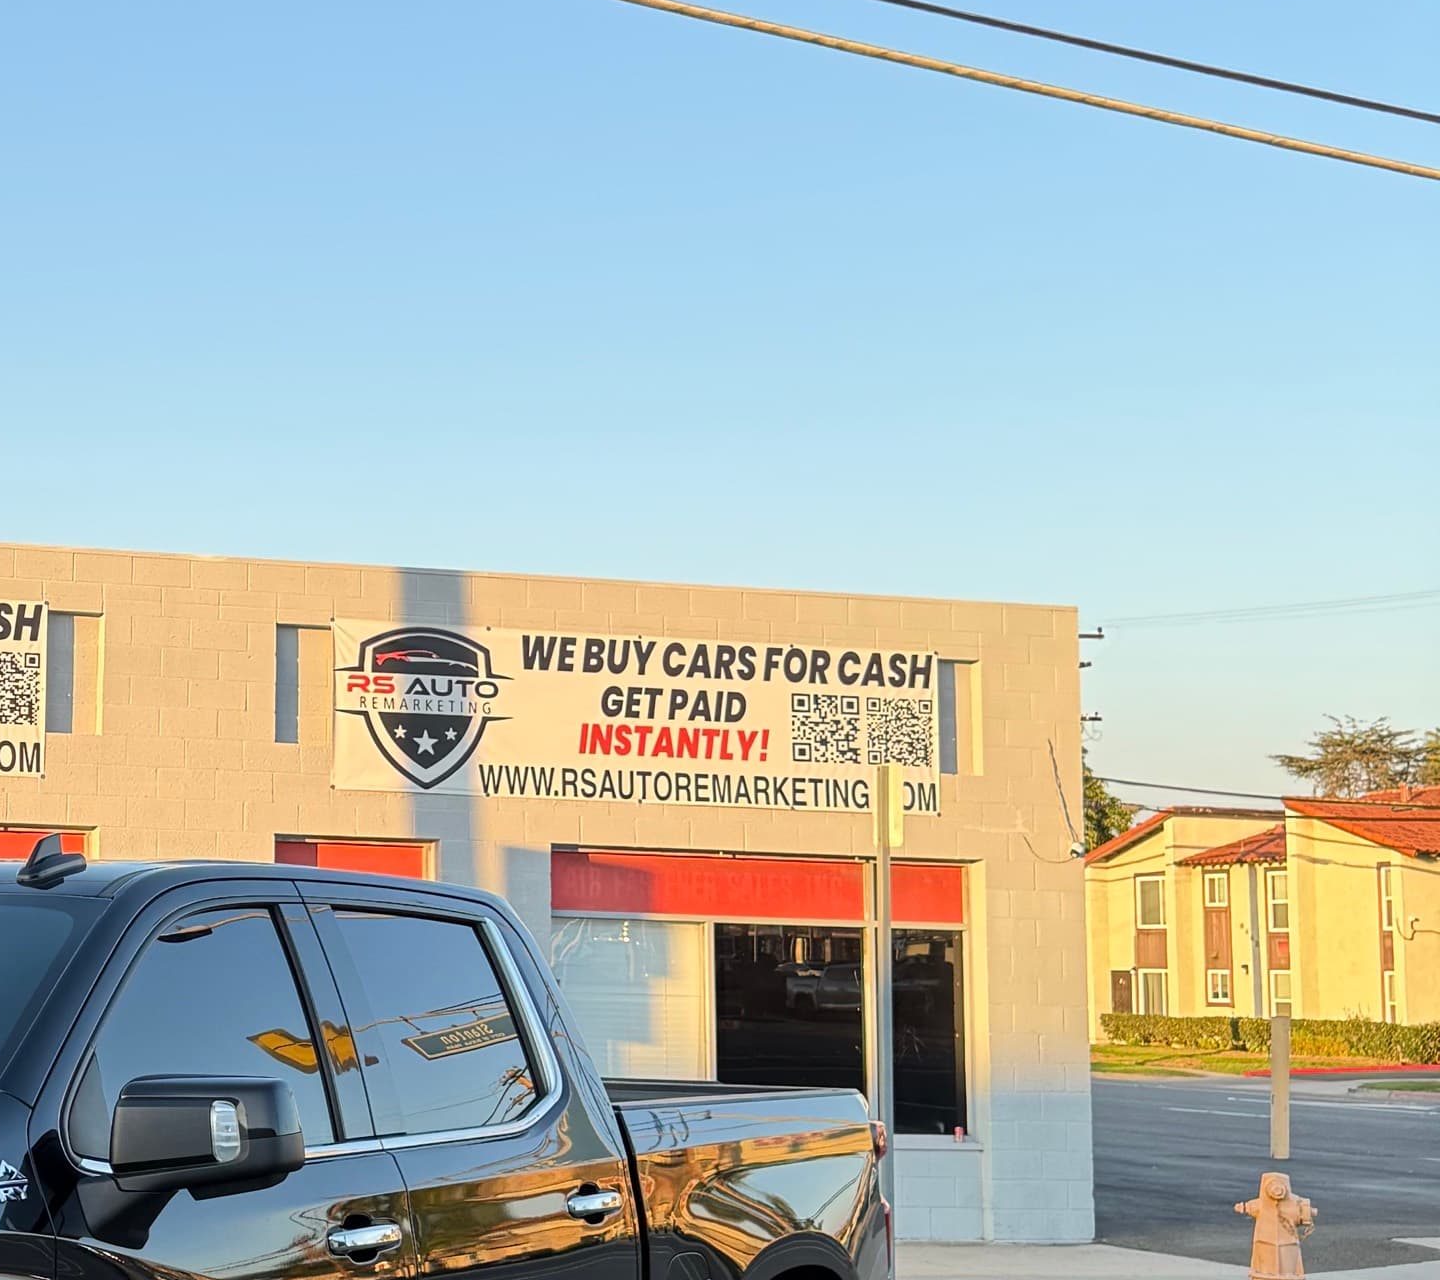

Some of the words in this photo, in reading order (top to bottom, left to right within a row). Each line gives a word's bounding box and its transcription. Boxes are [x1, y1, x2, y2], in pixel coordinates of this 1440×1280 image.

[522, 634, 577, 672] WE
[582, 638, 657, 676] BUY
[662, 642, 757, 681] CARS
[763, 647, 831, 685] FOR
[838, 651, 933, 689] CASH
[346, 674, 396, 695] RS
[404, 676, 499, 699] AUTO
[359, 695, 492, 715] REMARKETING
[601, 685, 664, 720] GET
[668, 688, 747, 723] PAID
[579, 722, 770, 761] INSTANTLY!
[478, 764, 937, 812] WWW.RSAUTOREMARKETINGOM
